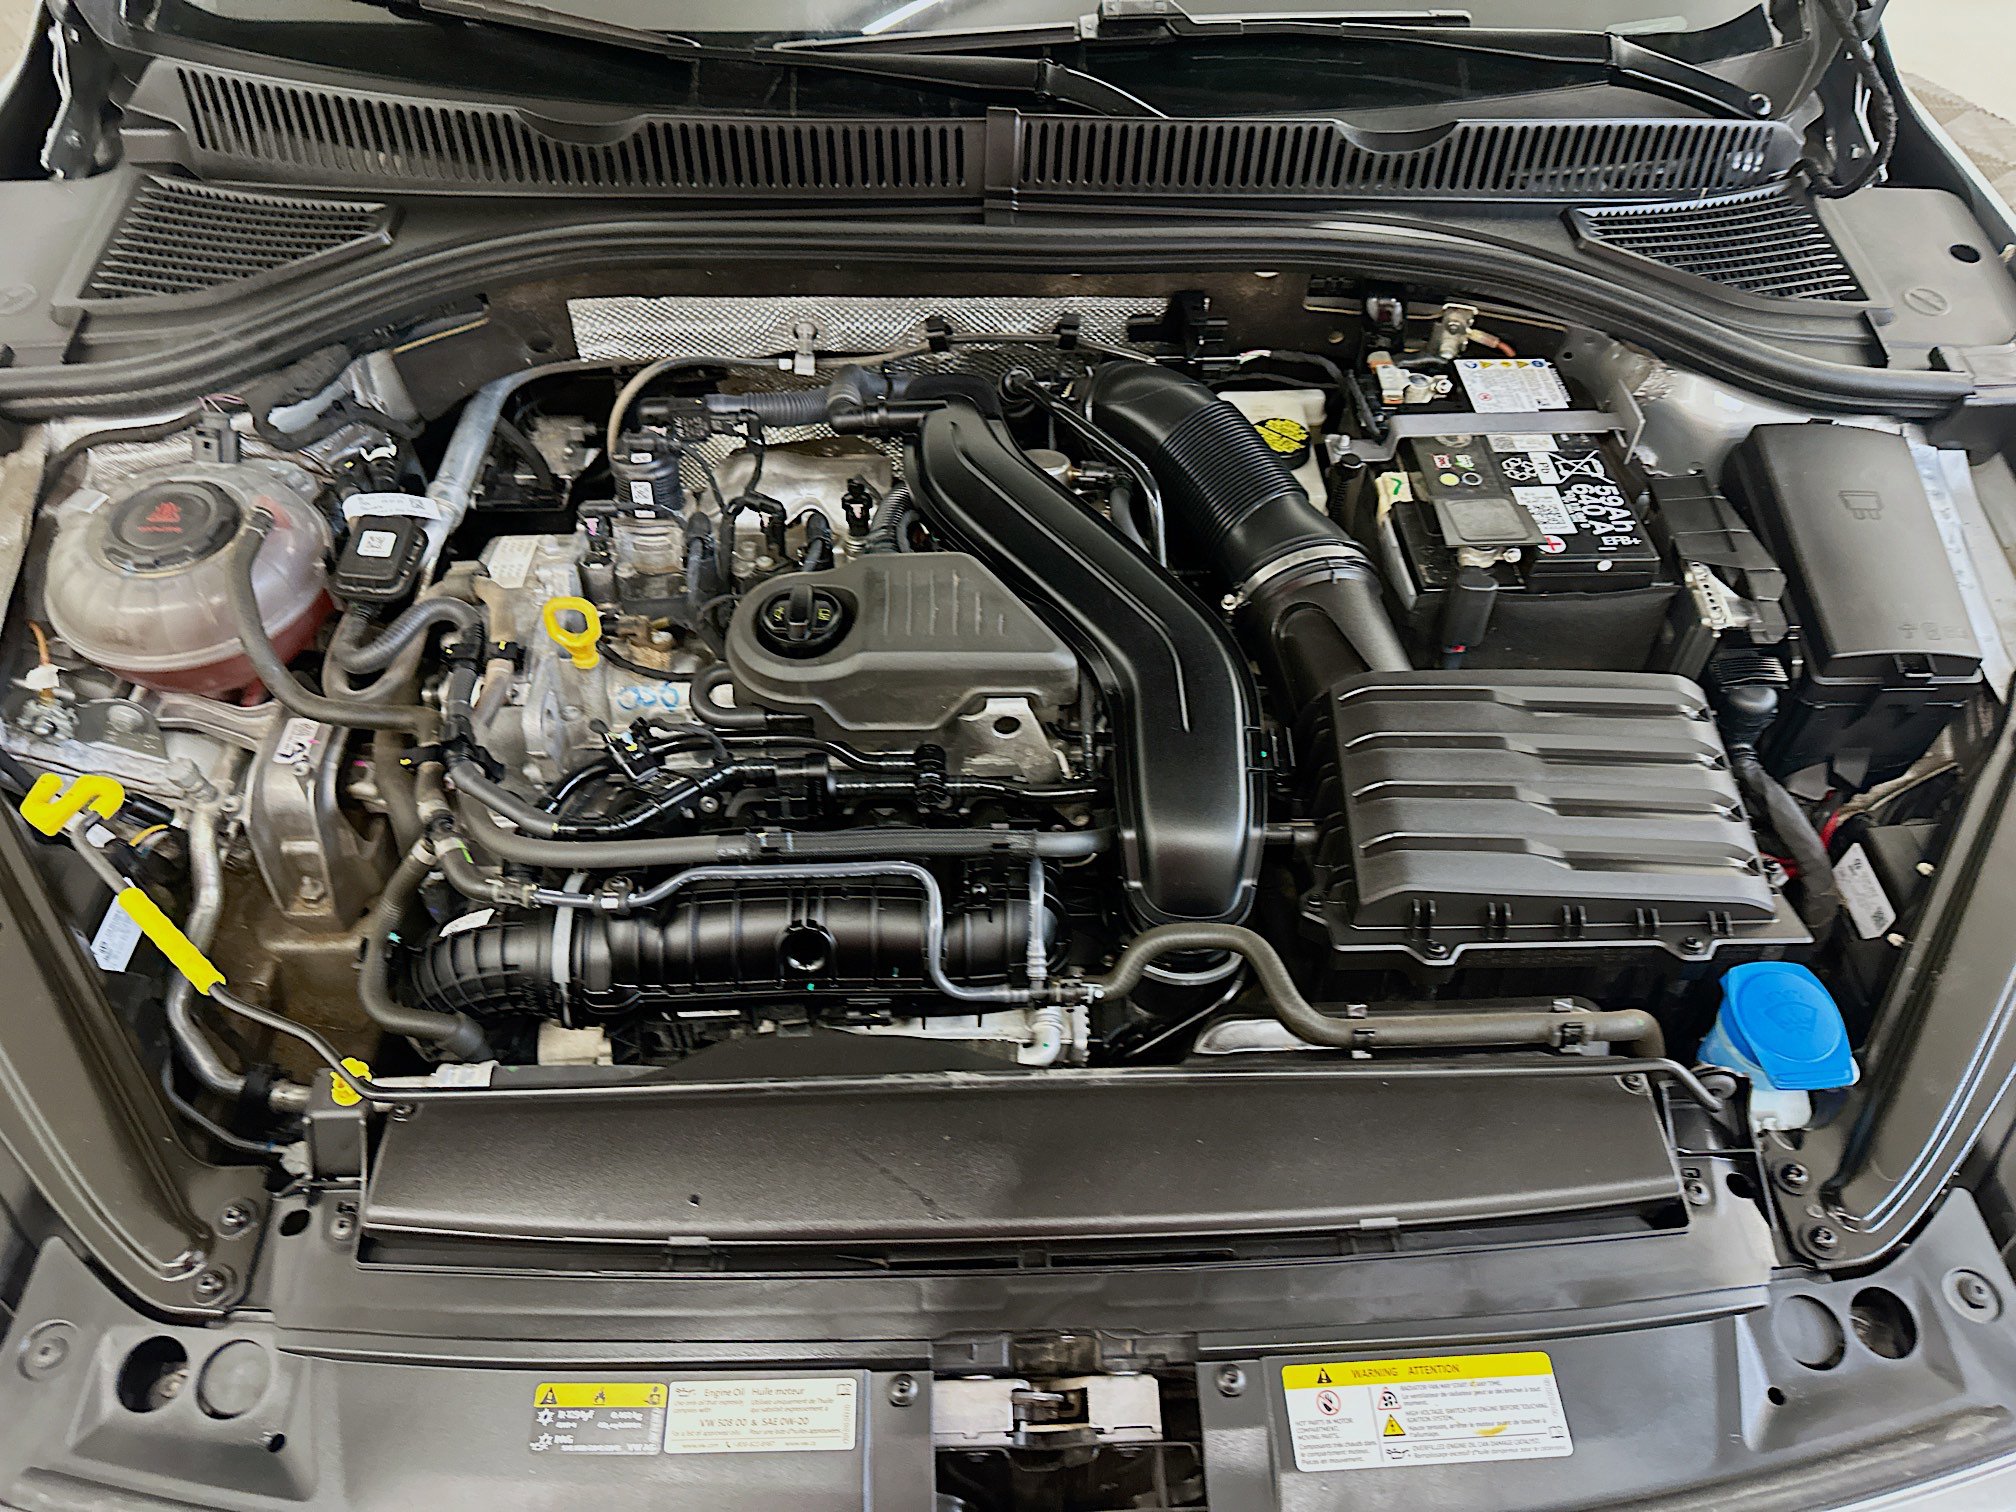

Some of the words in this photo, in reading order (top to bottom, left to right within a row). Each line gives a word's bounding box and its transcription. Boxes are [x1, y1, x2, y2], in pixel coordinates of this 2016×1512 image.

[1593, 485, 1637, 533] 59Ah
[1351, 1367, 1398, 1378] WARNING
[1408, 1364, 1460, 1375] ATTENTION
[704, 1388, 732, 1399] Engine
[733, 1387, 745, 1396] Oil
[752, 1388, 773, 1396] Huile
